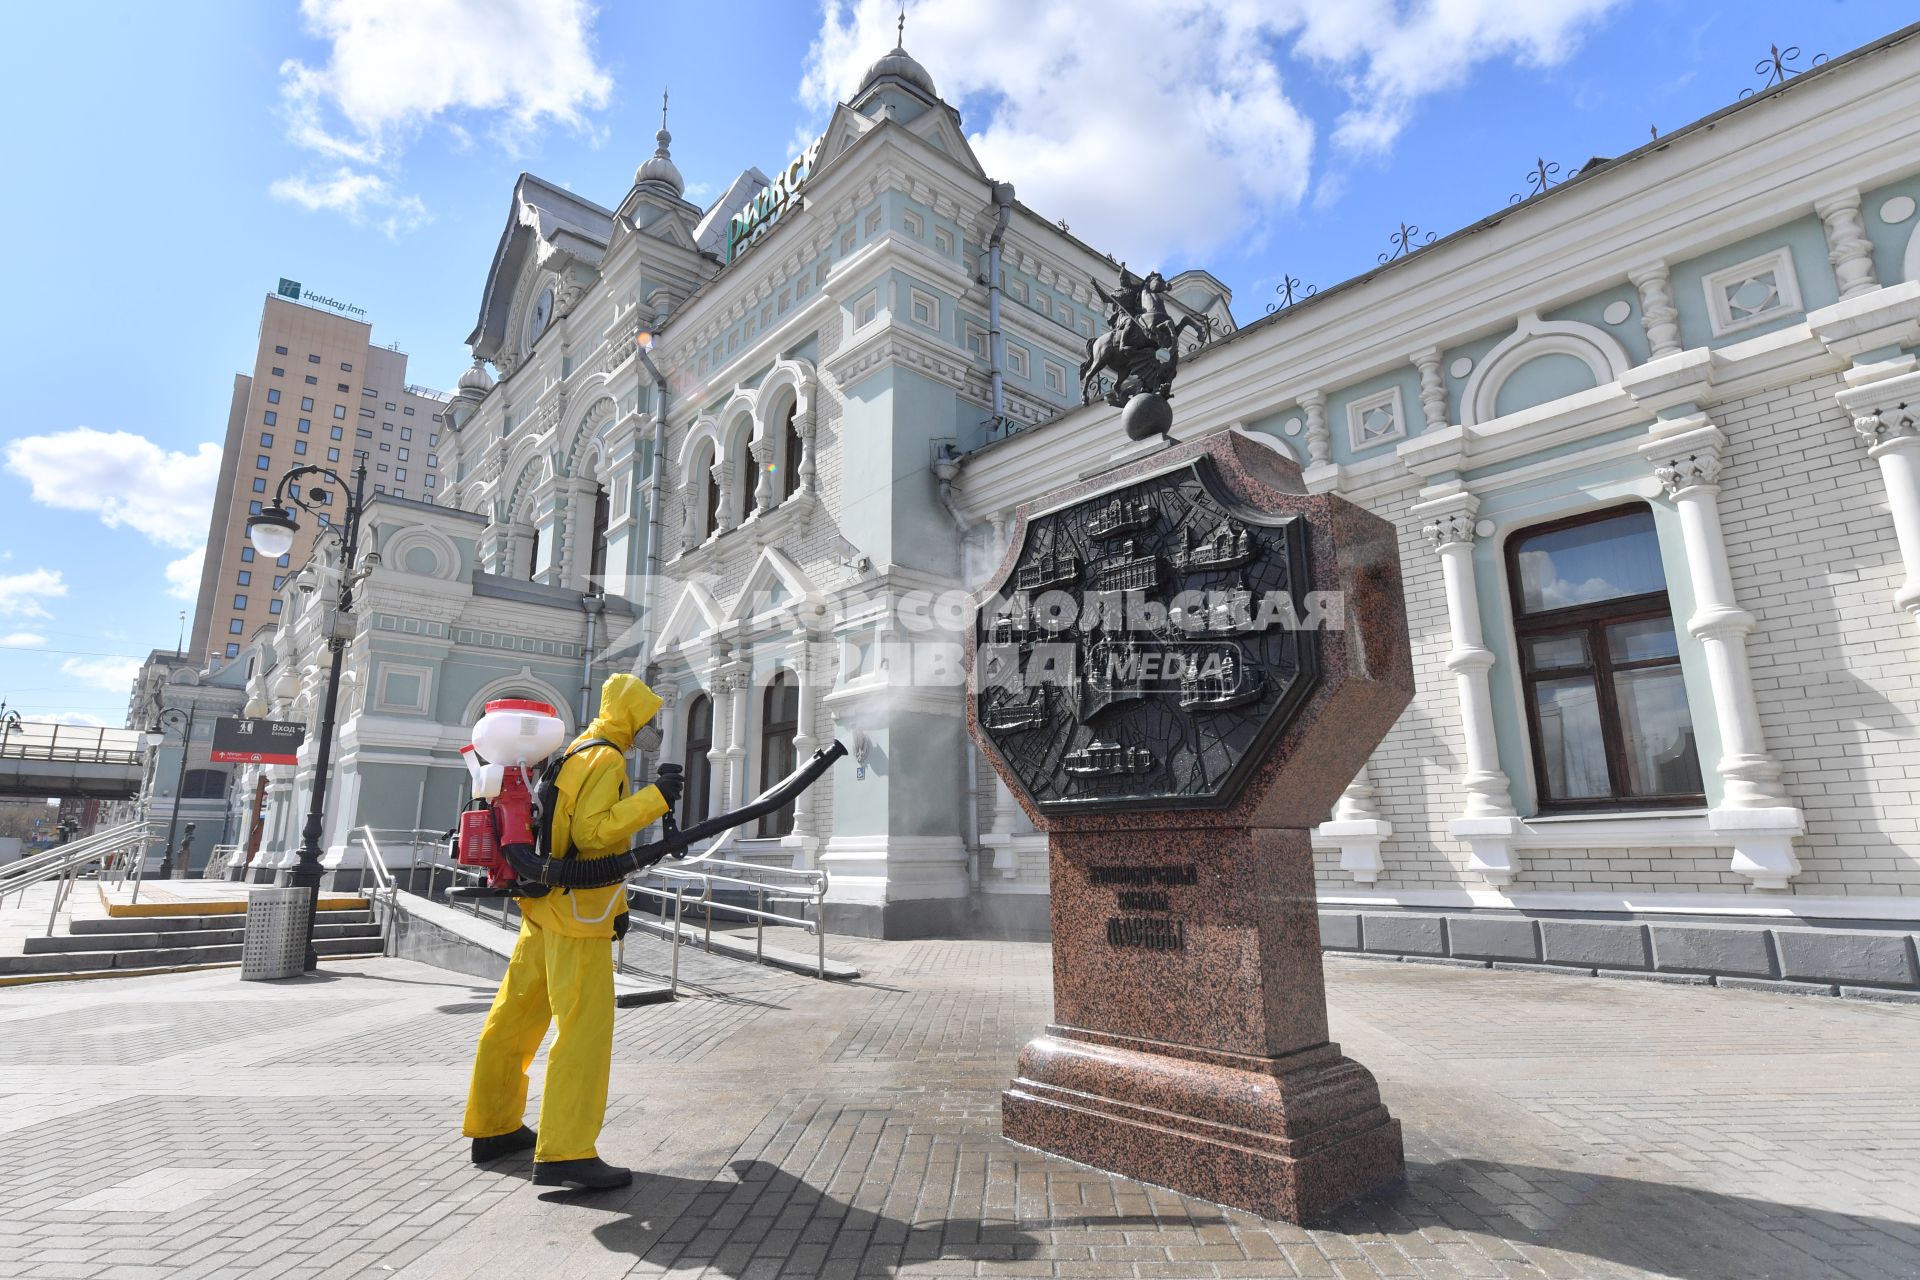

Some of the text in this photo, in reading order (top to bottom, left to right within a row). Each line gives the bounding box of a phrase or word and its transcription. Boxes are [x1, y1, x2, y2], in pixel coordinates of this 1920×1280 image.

[726, 132, 826, 268] РИЖСК
[303, 290, 347, 311] Holiday
[347, 302, 365, 315] Inn
[272, 723, 296, 734] Вход
